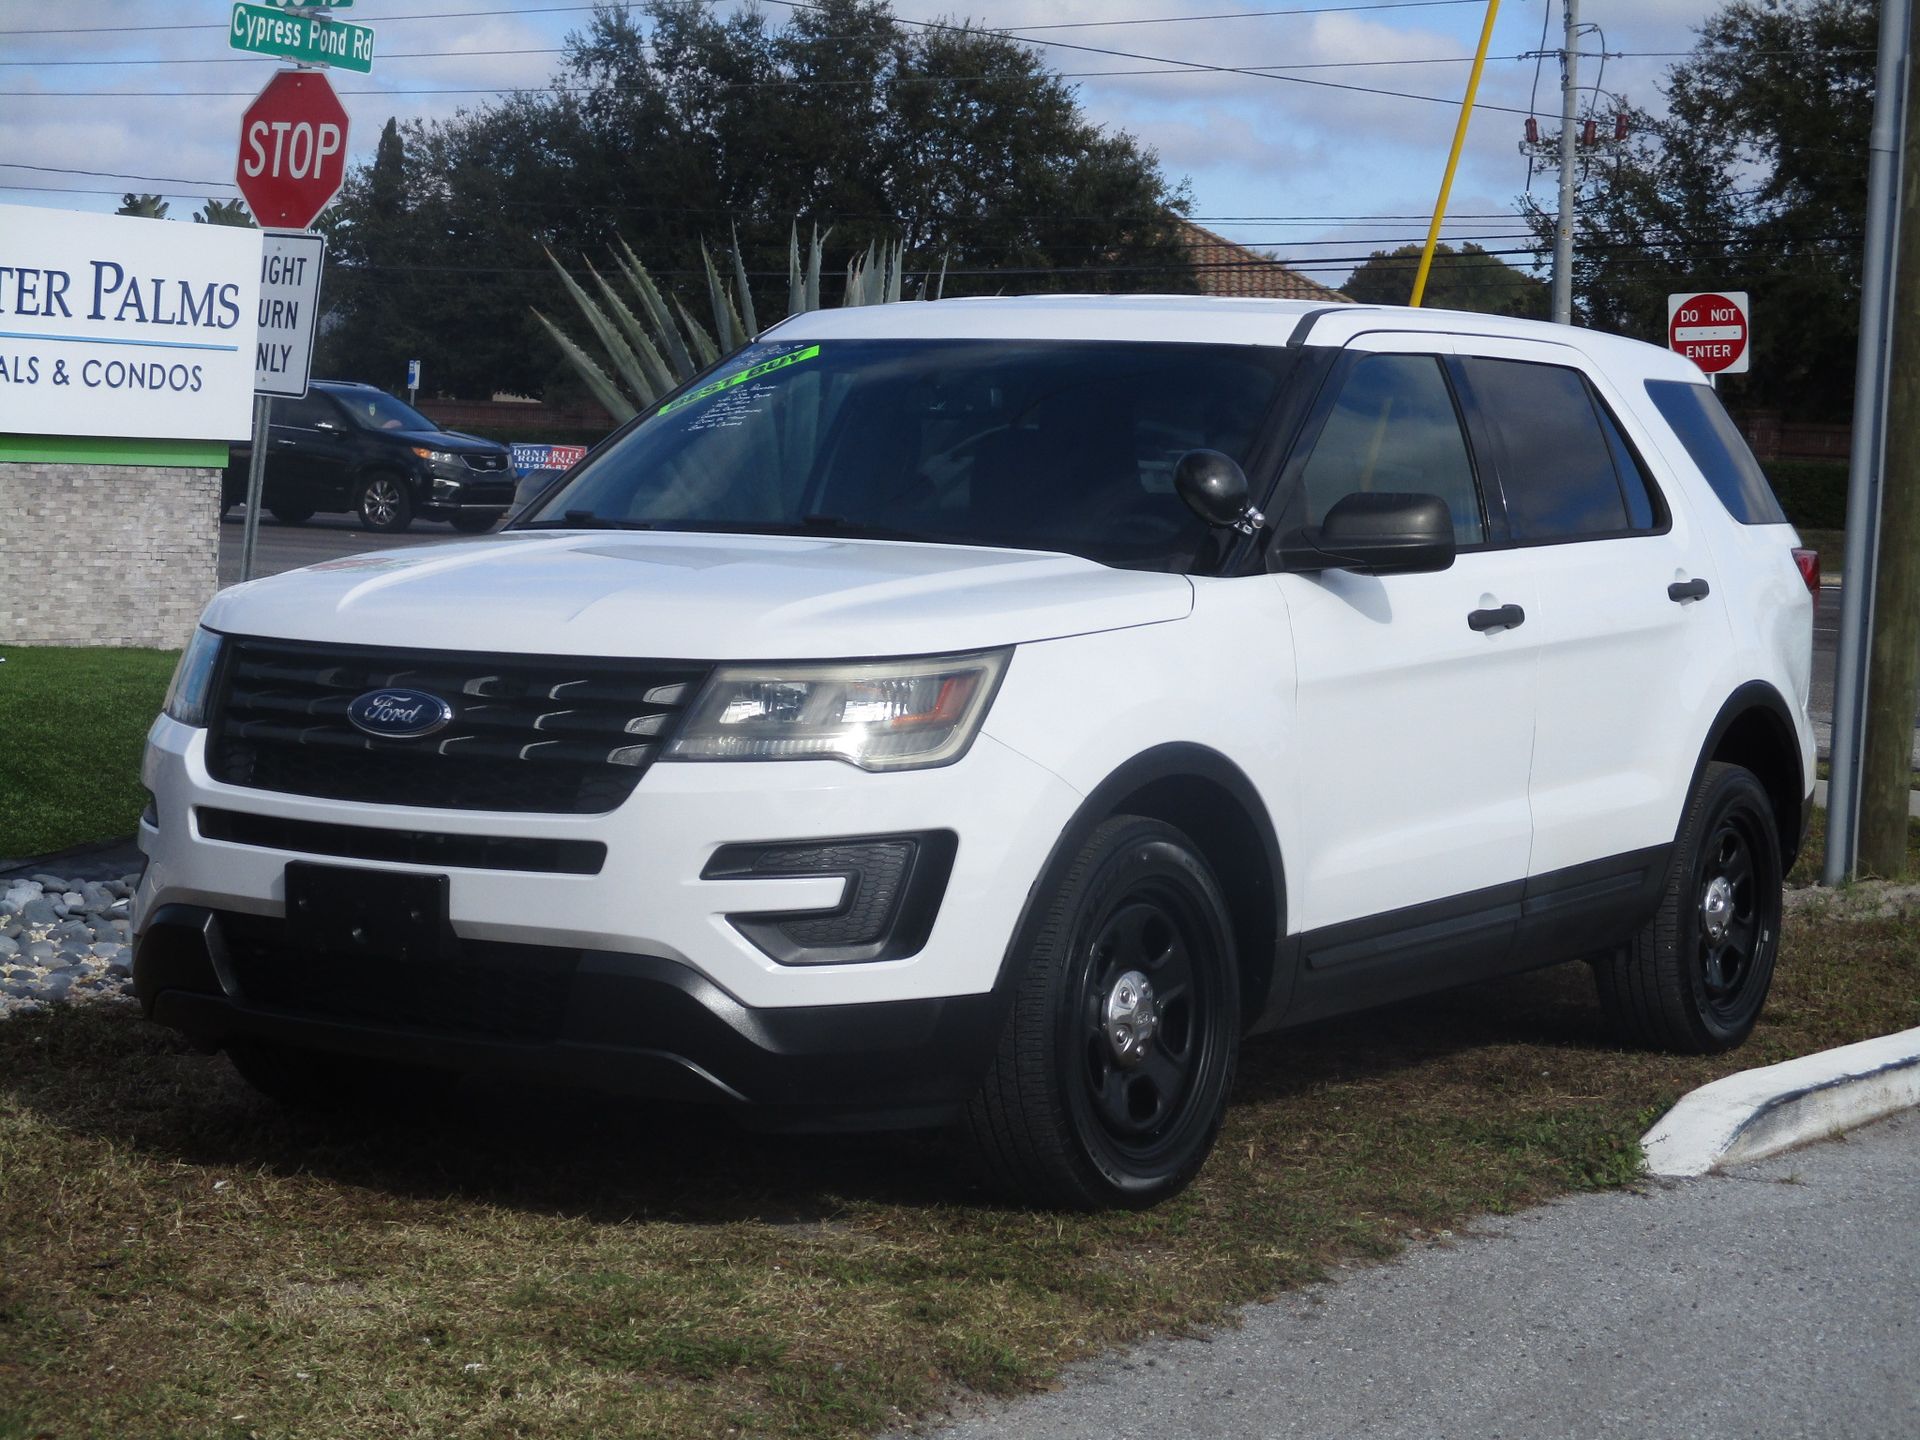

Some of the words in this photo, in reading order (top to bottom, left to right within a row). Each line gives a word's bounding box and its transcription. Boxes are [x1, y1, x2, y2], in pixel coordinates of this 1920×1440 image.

[234, 6, 301, 47] Cypress
[309, 20, 347, 56] Pond
[353, 29, 372, 60] Rd
[244, 121, 340, 179] STOP
[261, 256, 307, 286] IGHT
[87, 260, 240, 329] PALMS
[258, 299, 298, 329] URN
[1681, 310, 1699, 322] DO
[1711, 308, 1736, 321] NOT
[256, 343, 292, 373] NLY
[747, 349, 809, 379] BUY
[1686, 345, 1731, 358] ENTER
[52, 359, 70, 385] &
[82, 359, 202, 392] CONDOS
[513, 448, 548, 457] DONE
[552, 450, 582, 460] RITE
[364, 694, 423, 723] Ford
